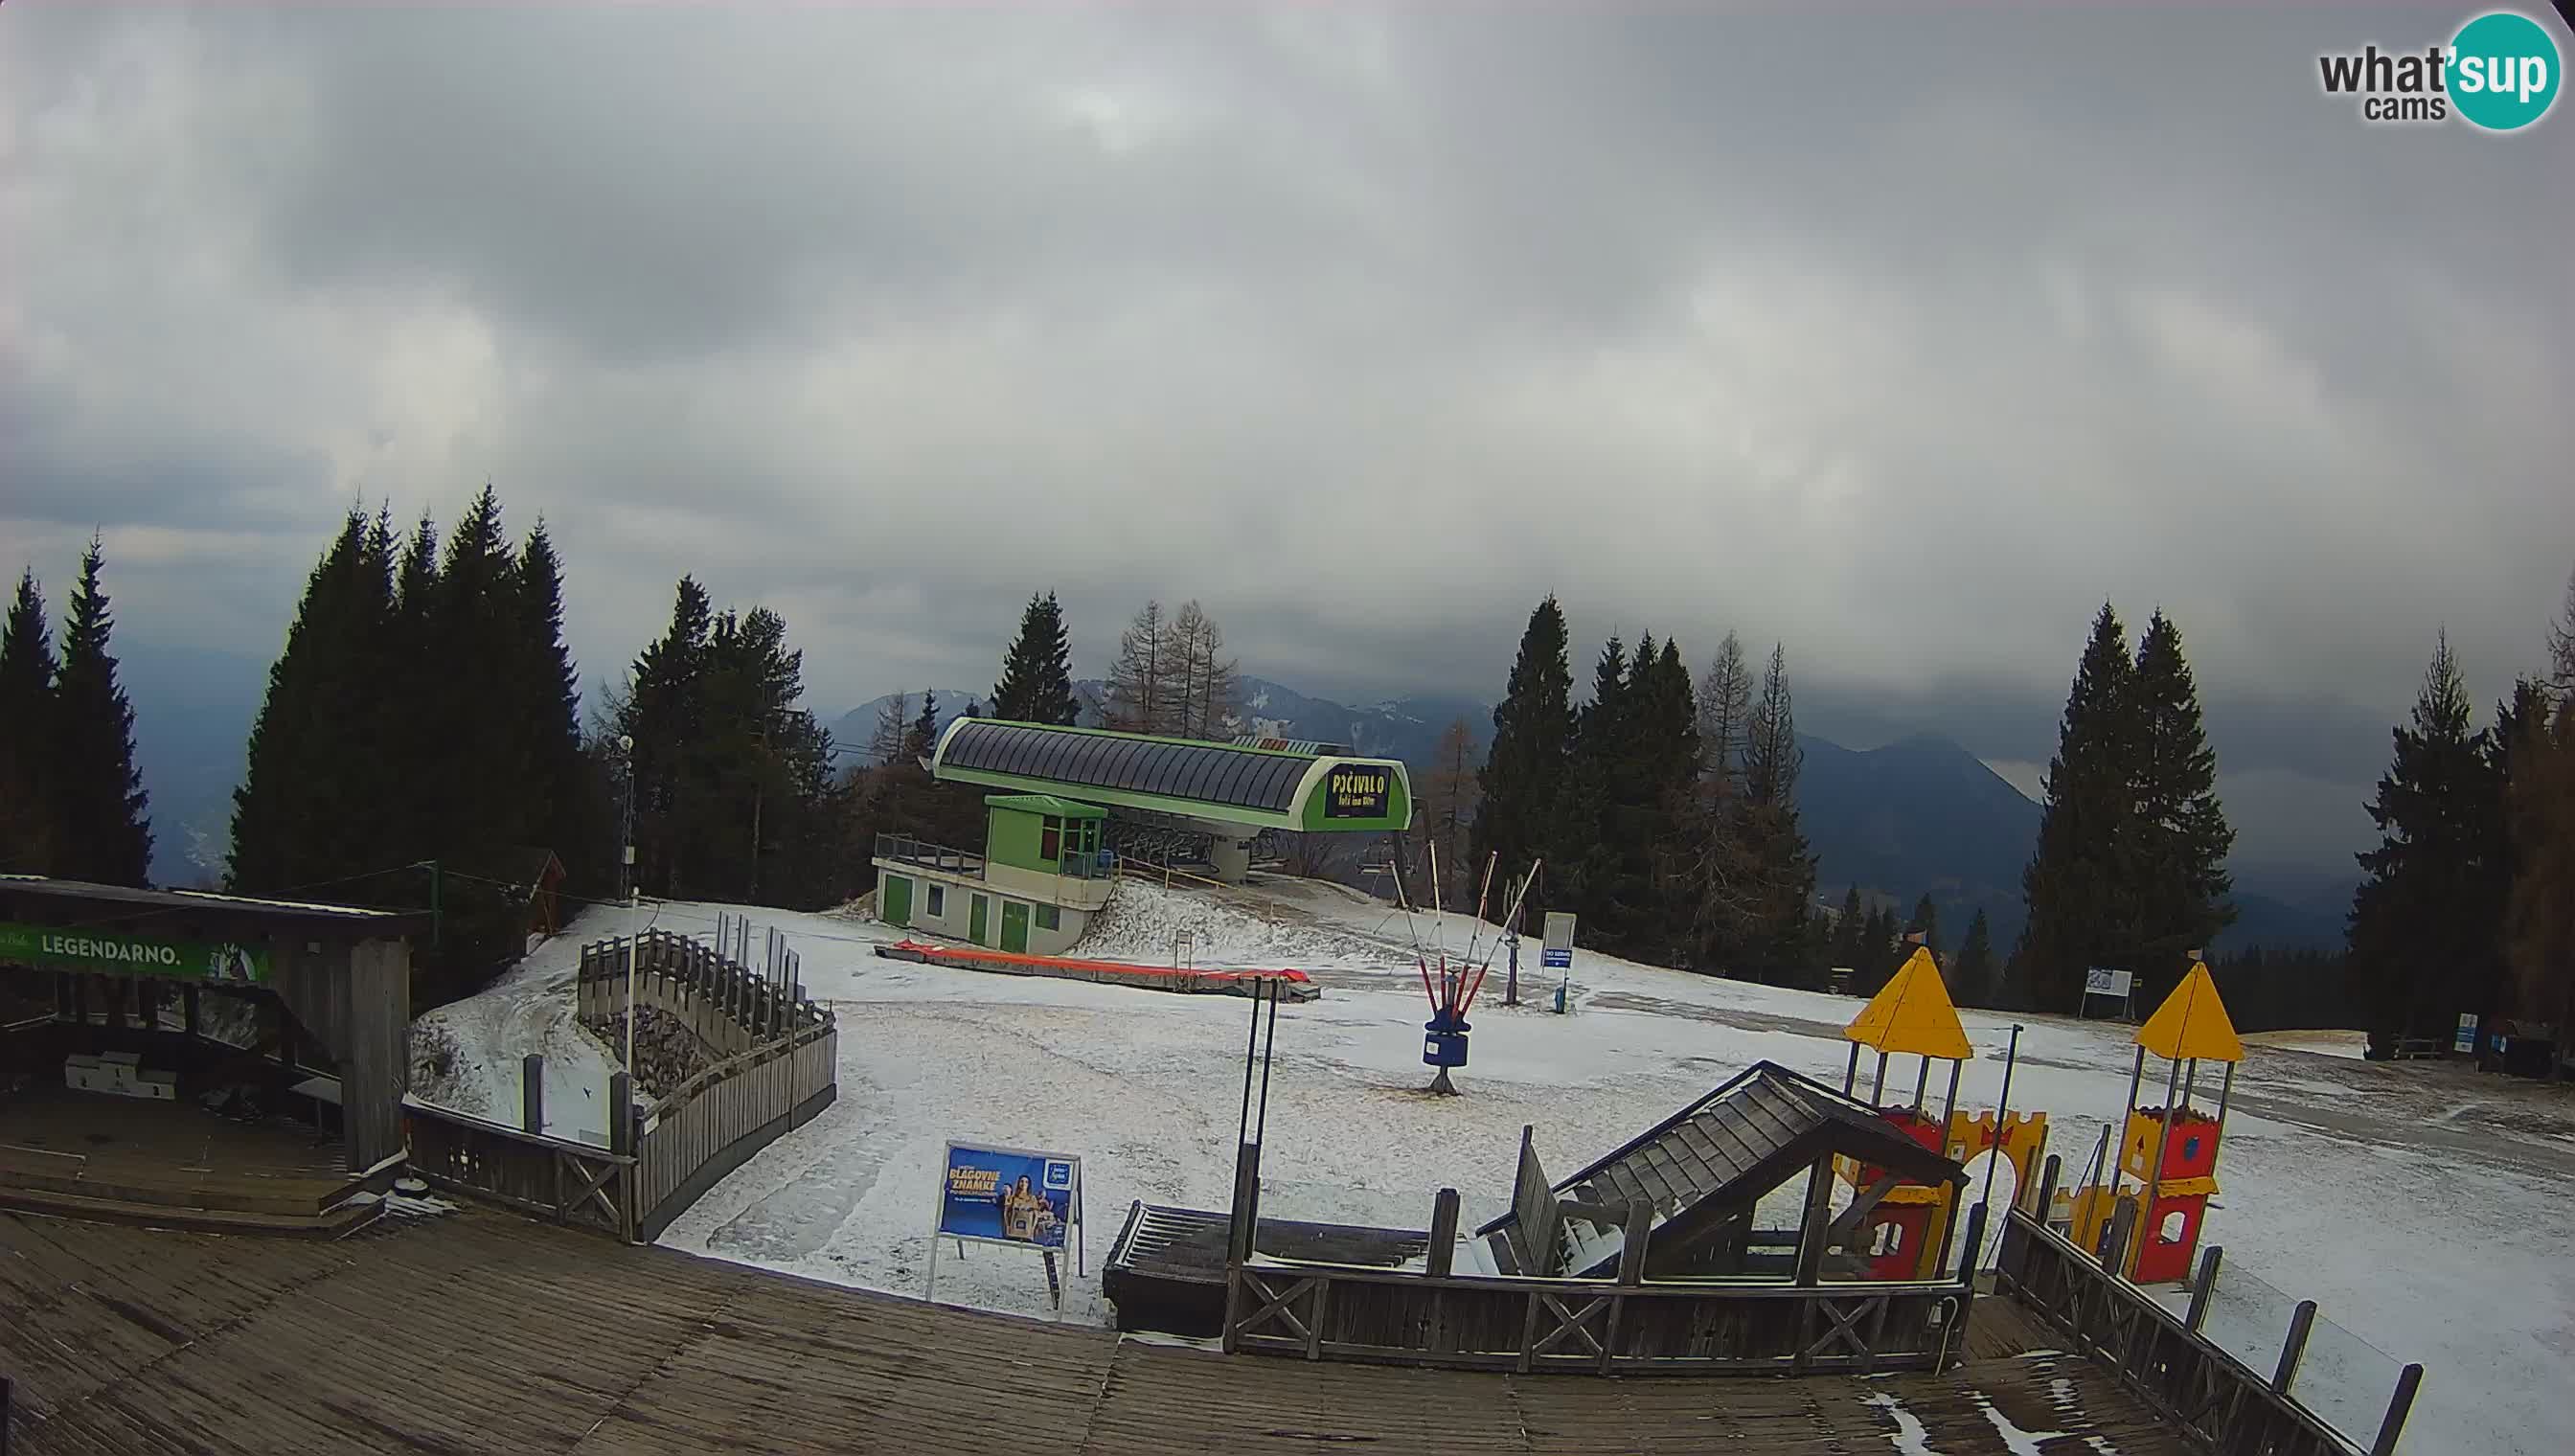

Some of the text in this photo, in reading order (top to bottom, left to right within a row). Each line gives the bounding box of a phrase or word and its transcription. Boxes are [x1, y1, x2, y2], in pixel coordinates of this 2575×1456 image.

[41, 935, 181, 966] LEGENDARNO.
[949, 1168, 1001, 1181] BLAGOVNE
[951, 1179, 996, 1191] ZNAMKE
